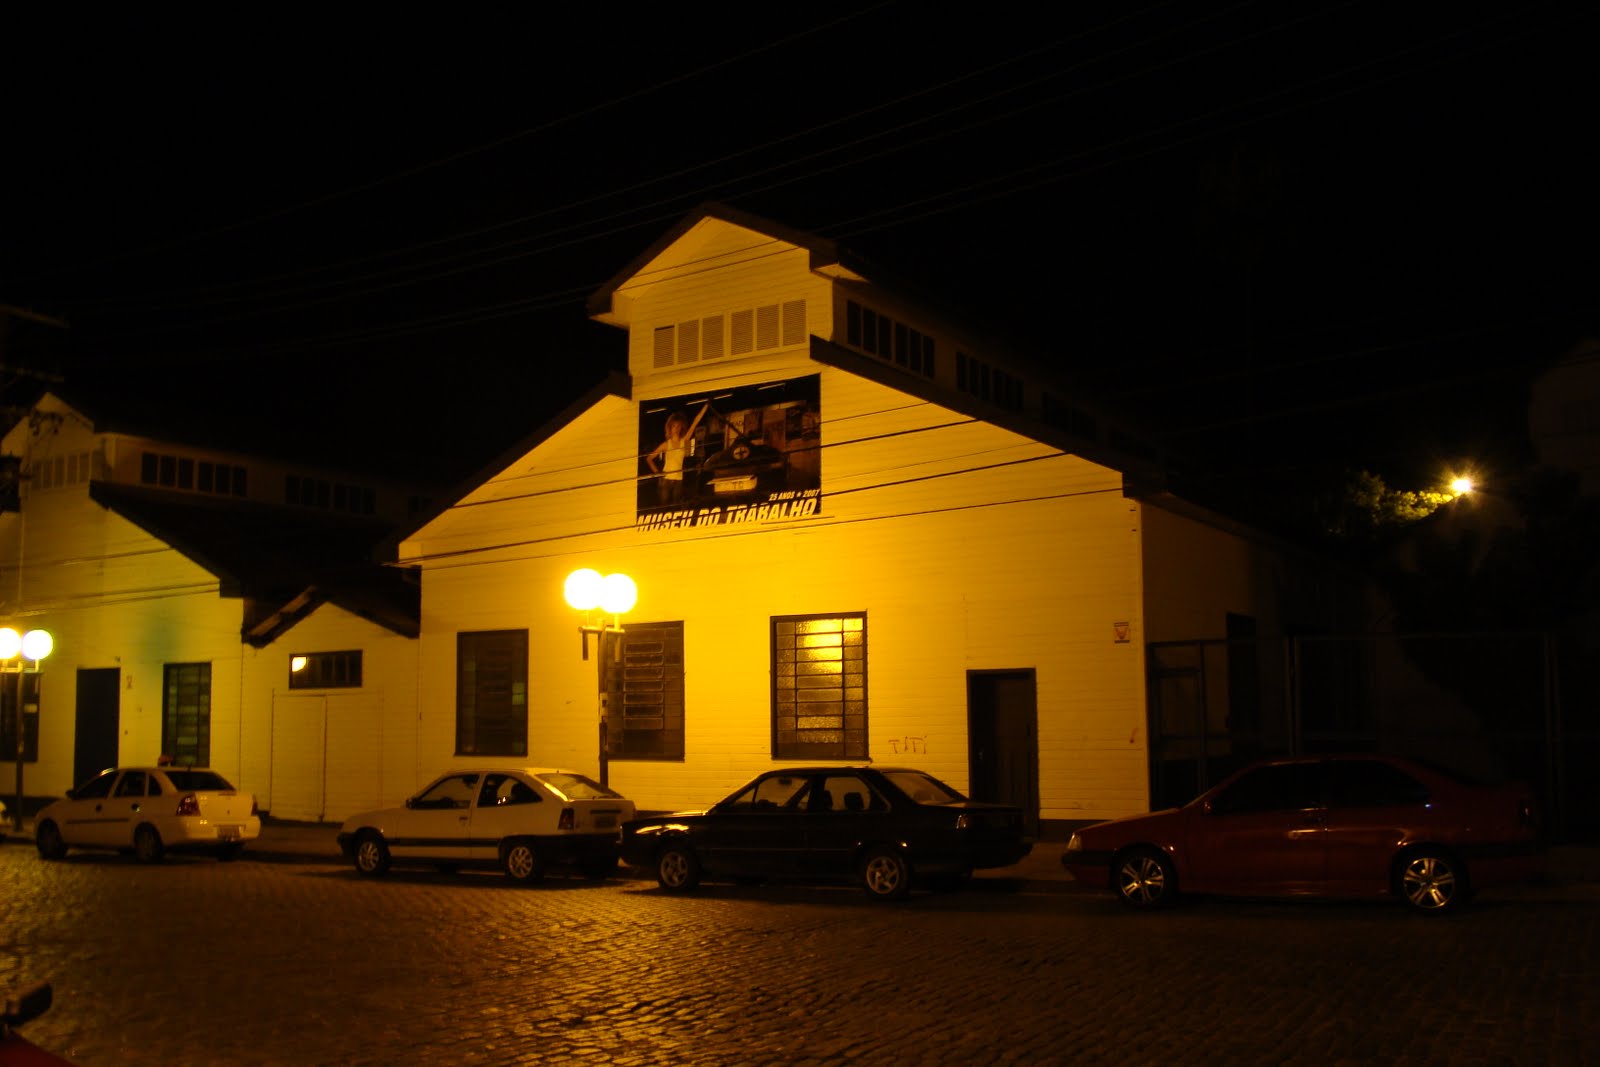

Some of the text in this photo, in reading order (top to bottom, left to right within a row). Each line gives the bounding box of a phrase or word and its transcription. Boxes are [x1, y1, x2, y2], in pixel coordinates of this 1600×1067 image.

[768, 489, 821, 501] 25 ANOS 2007
[637, 498, 818, 532] MUSEU DO TRABALHO
